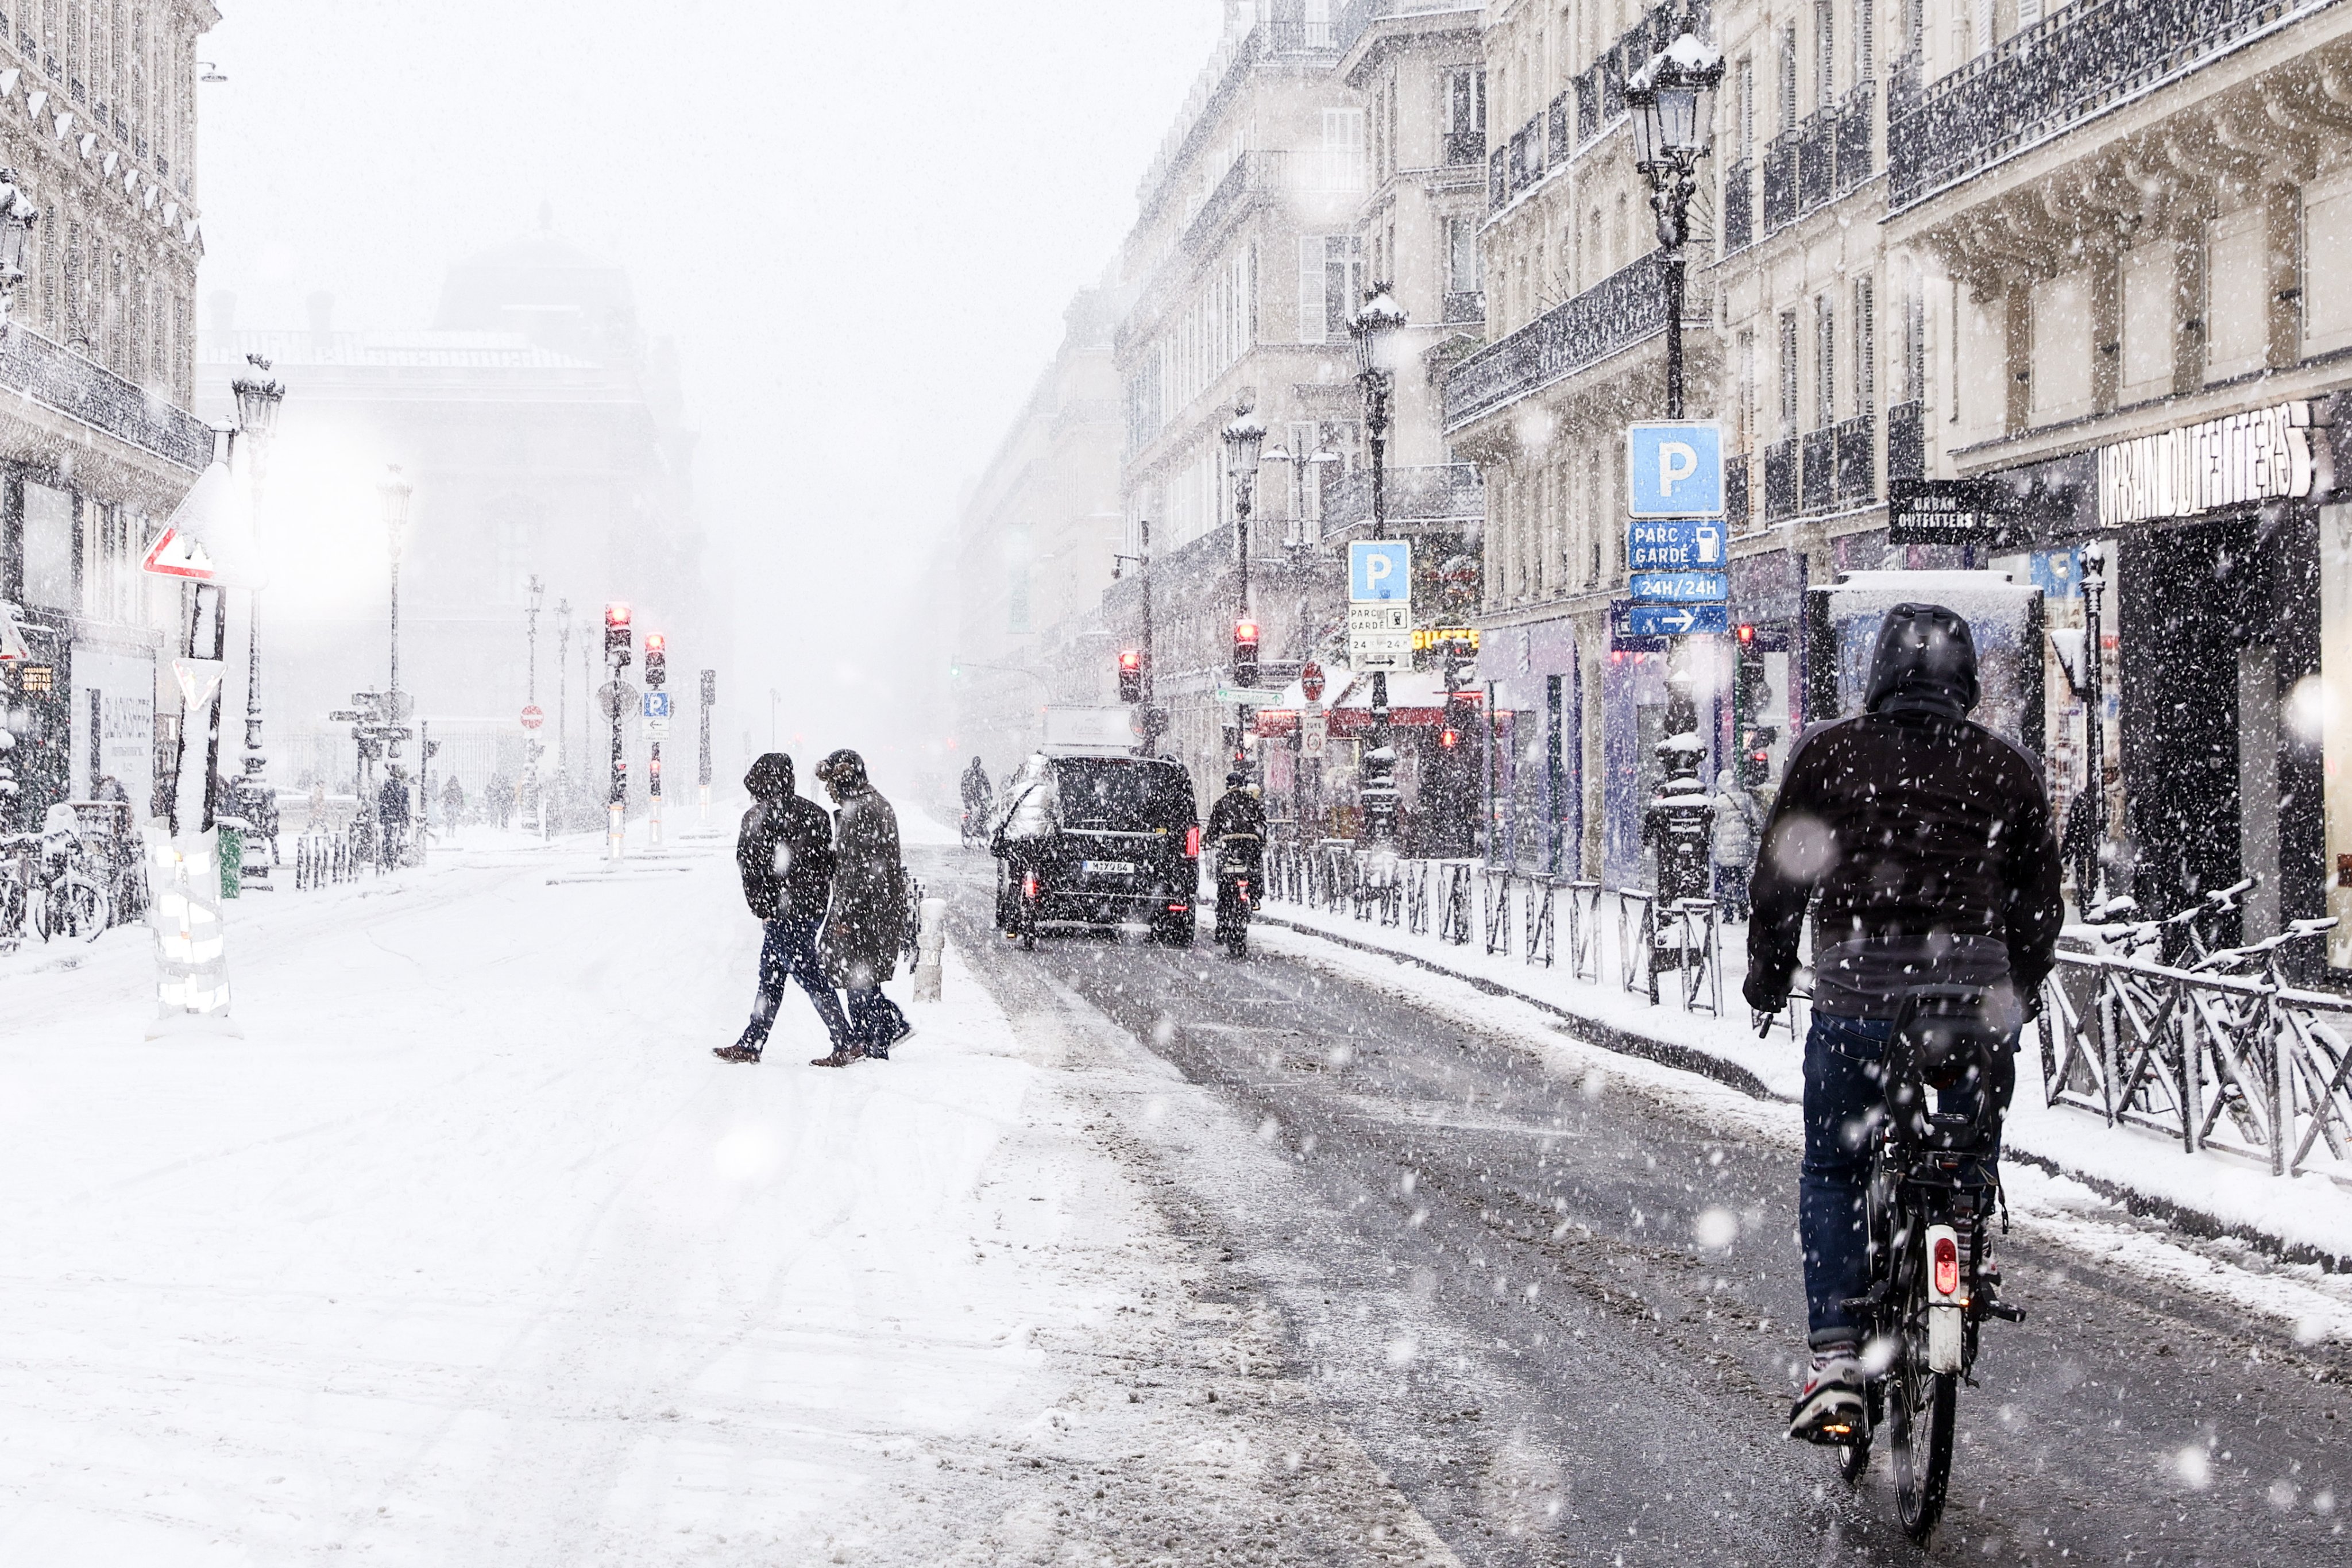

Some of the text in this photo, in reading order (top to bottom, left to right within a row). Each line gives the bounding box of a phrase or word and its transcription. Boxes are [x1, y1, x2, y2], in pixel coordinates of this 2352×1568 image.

[1659, 442, 1698, 497] P
[2098, 401, 2309, 528] URBAN OUTFITTERS
[1914, 496, 1956, 511] URBAN
[1898, 512, 1972, 528] OUTFITTERS
[1635, 527, 1678, 543] PARC
[1636, 544, 1689, 563] GARDÉ
[1366, 554, 1392, 590] P
[1642, 579, 1716, 597] 24H/24H
[1351, 609, 1377, 617] PARC
[1351, 620, 1385, 629] GARDÉ
[24, 682, 52, 690] COFFEE
[650, 696, 663, 713] P
